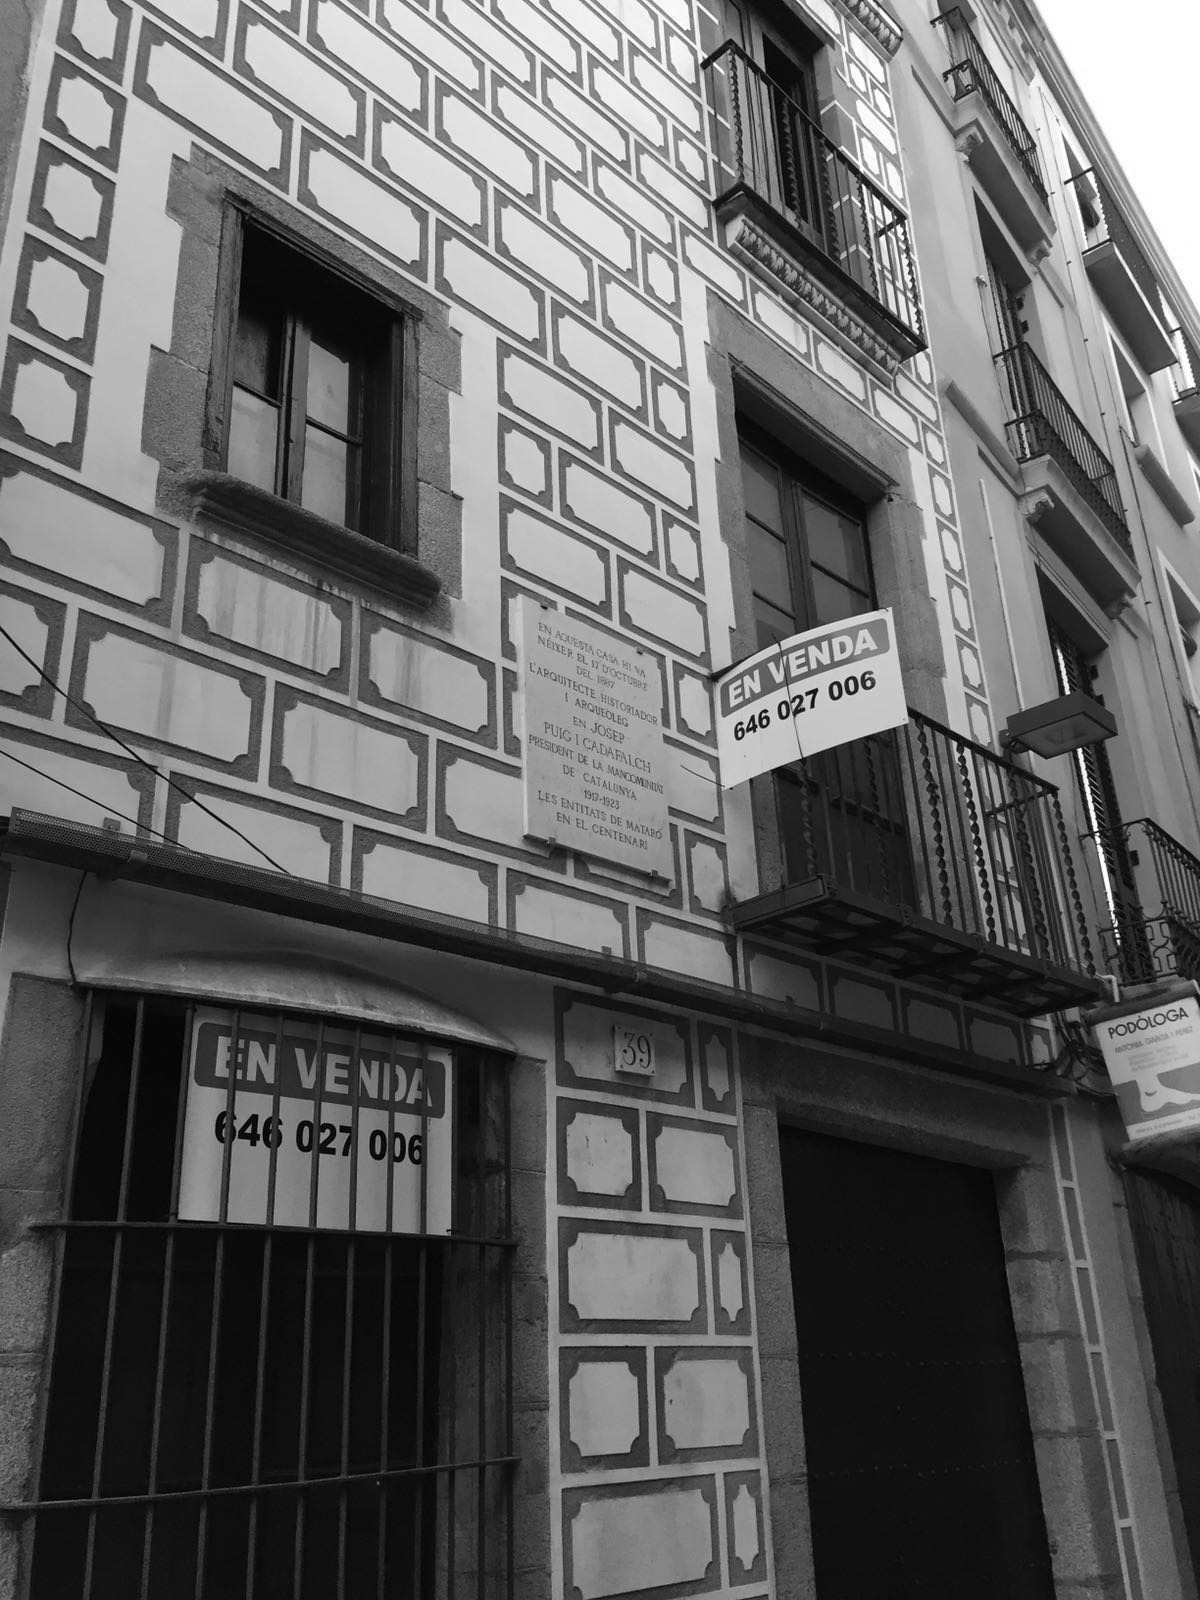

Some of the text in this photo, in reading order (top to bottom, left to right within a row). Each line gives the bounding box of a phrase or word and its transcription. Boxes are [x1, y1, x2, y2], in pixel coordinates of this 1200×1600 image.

[538, 622, 646, 678] EN AQUESTA CASA HI VA
[538, 635, 648, 692] NÉIXER EL 17 D'OCTUBRE
[576, 665, 593, 680] DEL
[728, 628, 878, 708] EN VENDA
[529, 662, 658, 726] L'ARQUITECTE HISTORIADOR
[734, 670, 876, 741] 646 027 006
[528, 734, 574, 760] PRESIDENT
[577, 753, 589, 765] DE
[592, 759, 604, 771] LA
[544, 720, 572, 742] PUIG
[583, 737, 651, 773] CADAFALCH
[572, 716, 625, 744] EN JOSEP
[562, 764, 637, 801] DE CATALUNYA
[538, 790, 663, 840] LES ENTITATS DE MATARÓ
[556, 812, 648, 850] EN EL CENTENARI
[1108, 1006, 1189, 1039] PODÒLOGA
[214, 1035, 433, 1108] EN VENDA
[623, 1032, 651, 1069] 39
[214, 1110, 424, 1165] 646 027 006
